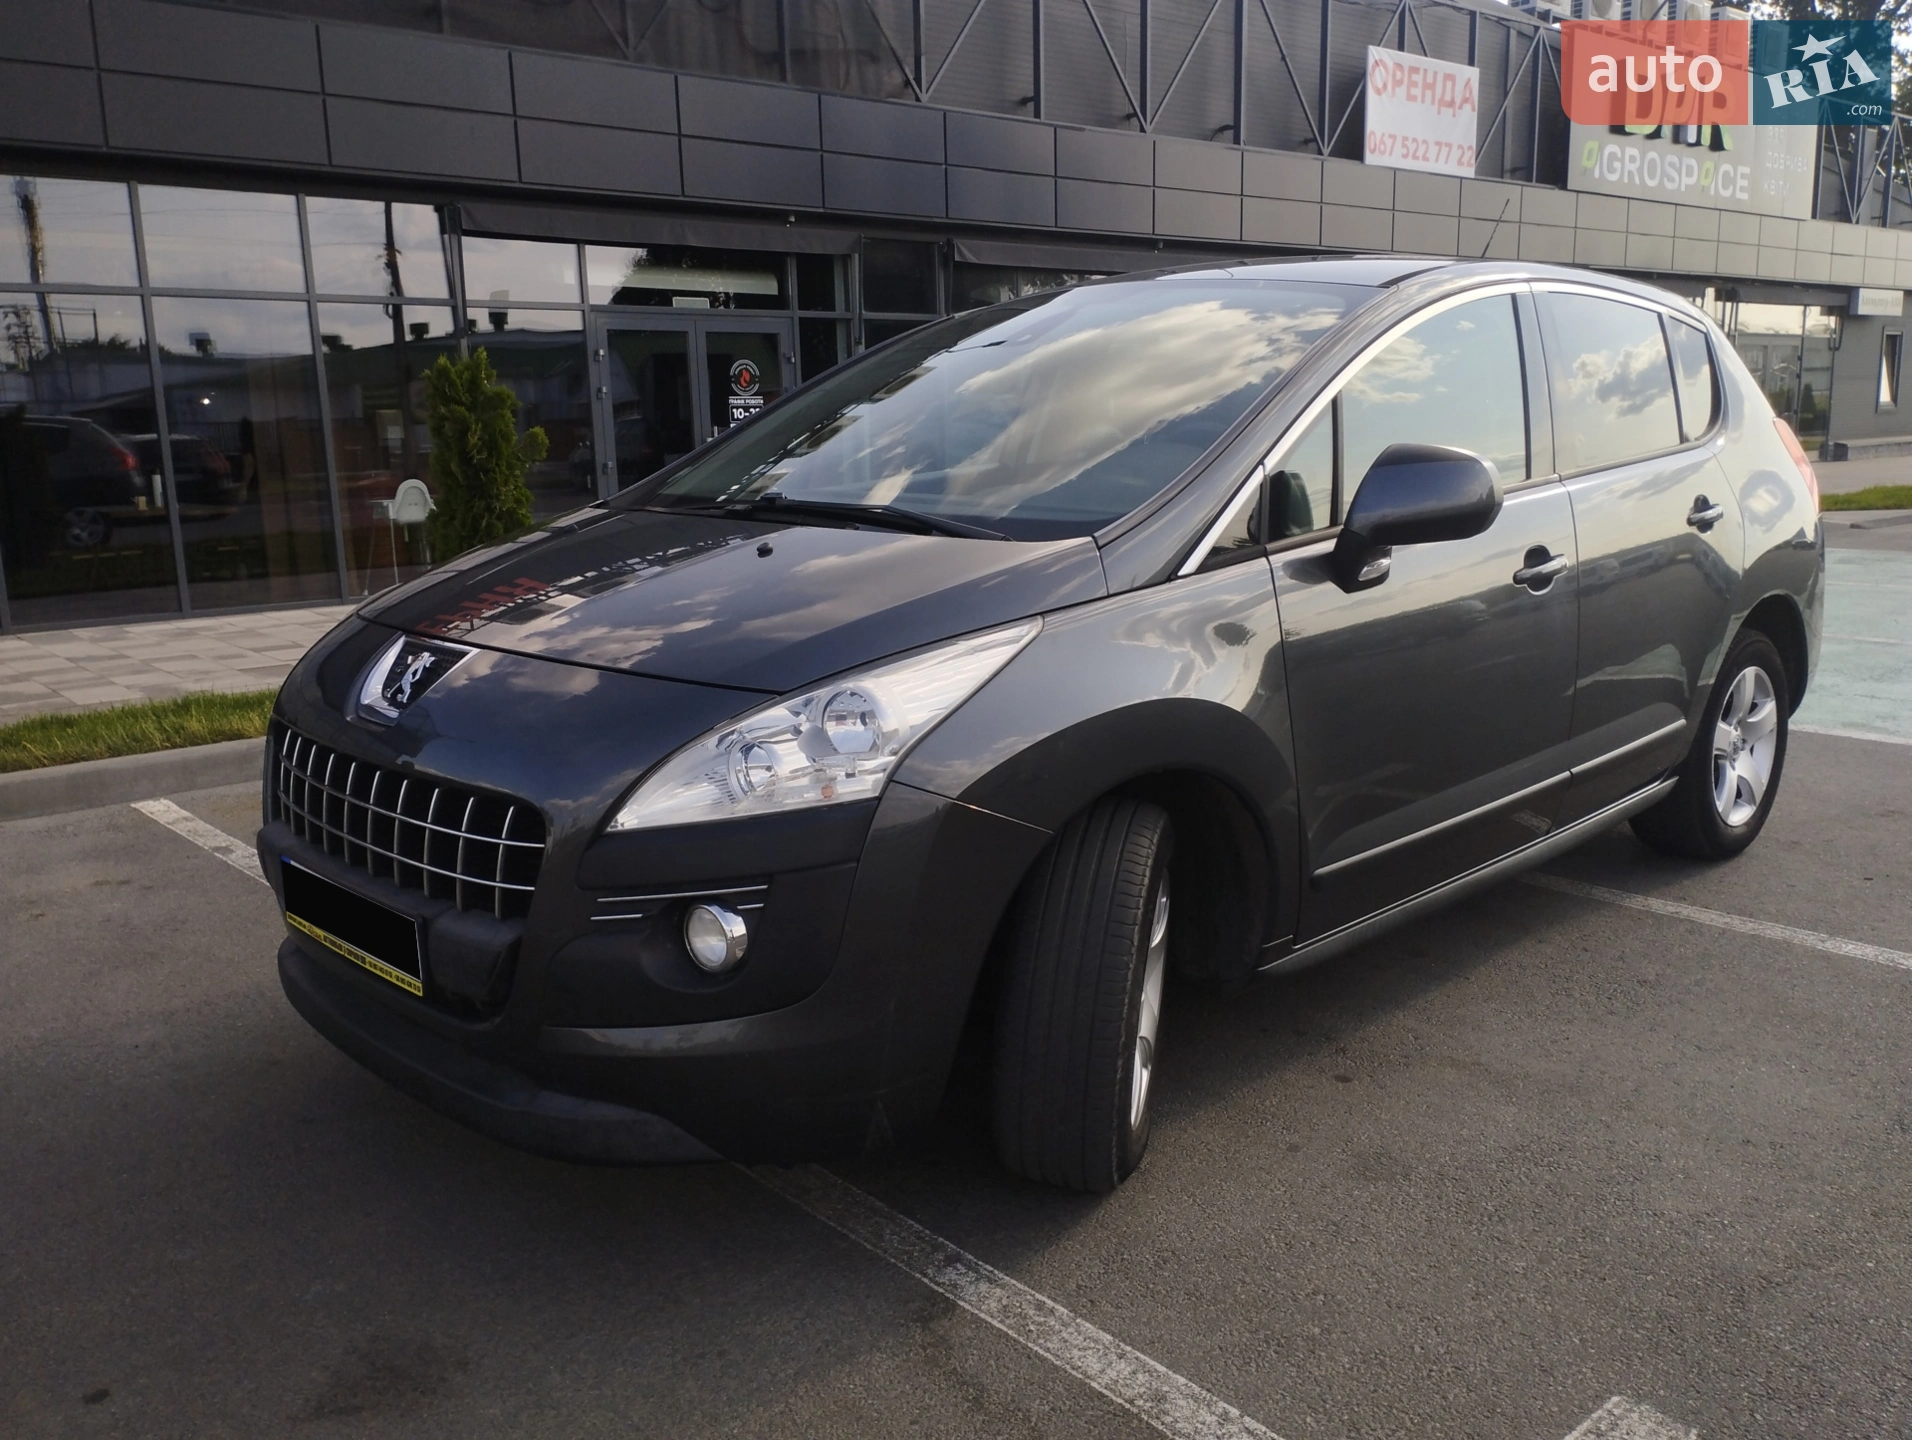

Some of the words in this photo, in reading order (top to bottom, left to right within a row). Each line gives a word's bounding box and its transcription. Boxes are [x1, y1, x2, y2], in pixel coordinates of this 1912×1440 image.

[1369, 58, 1476, 118] ОРЕНДА
[1367, 129, 1397, 157] 067
[1401, 136, 1430, 162] 522
[1434, 141, 1453, 165] 77
[1457, 144, 1476, 168] 22
